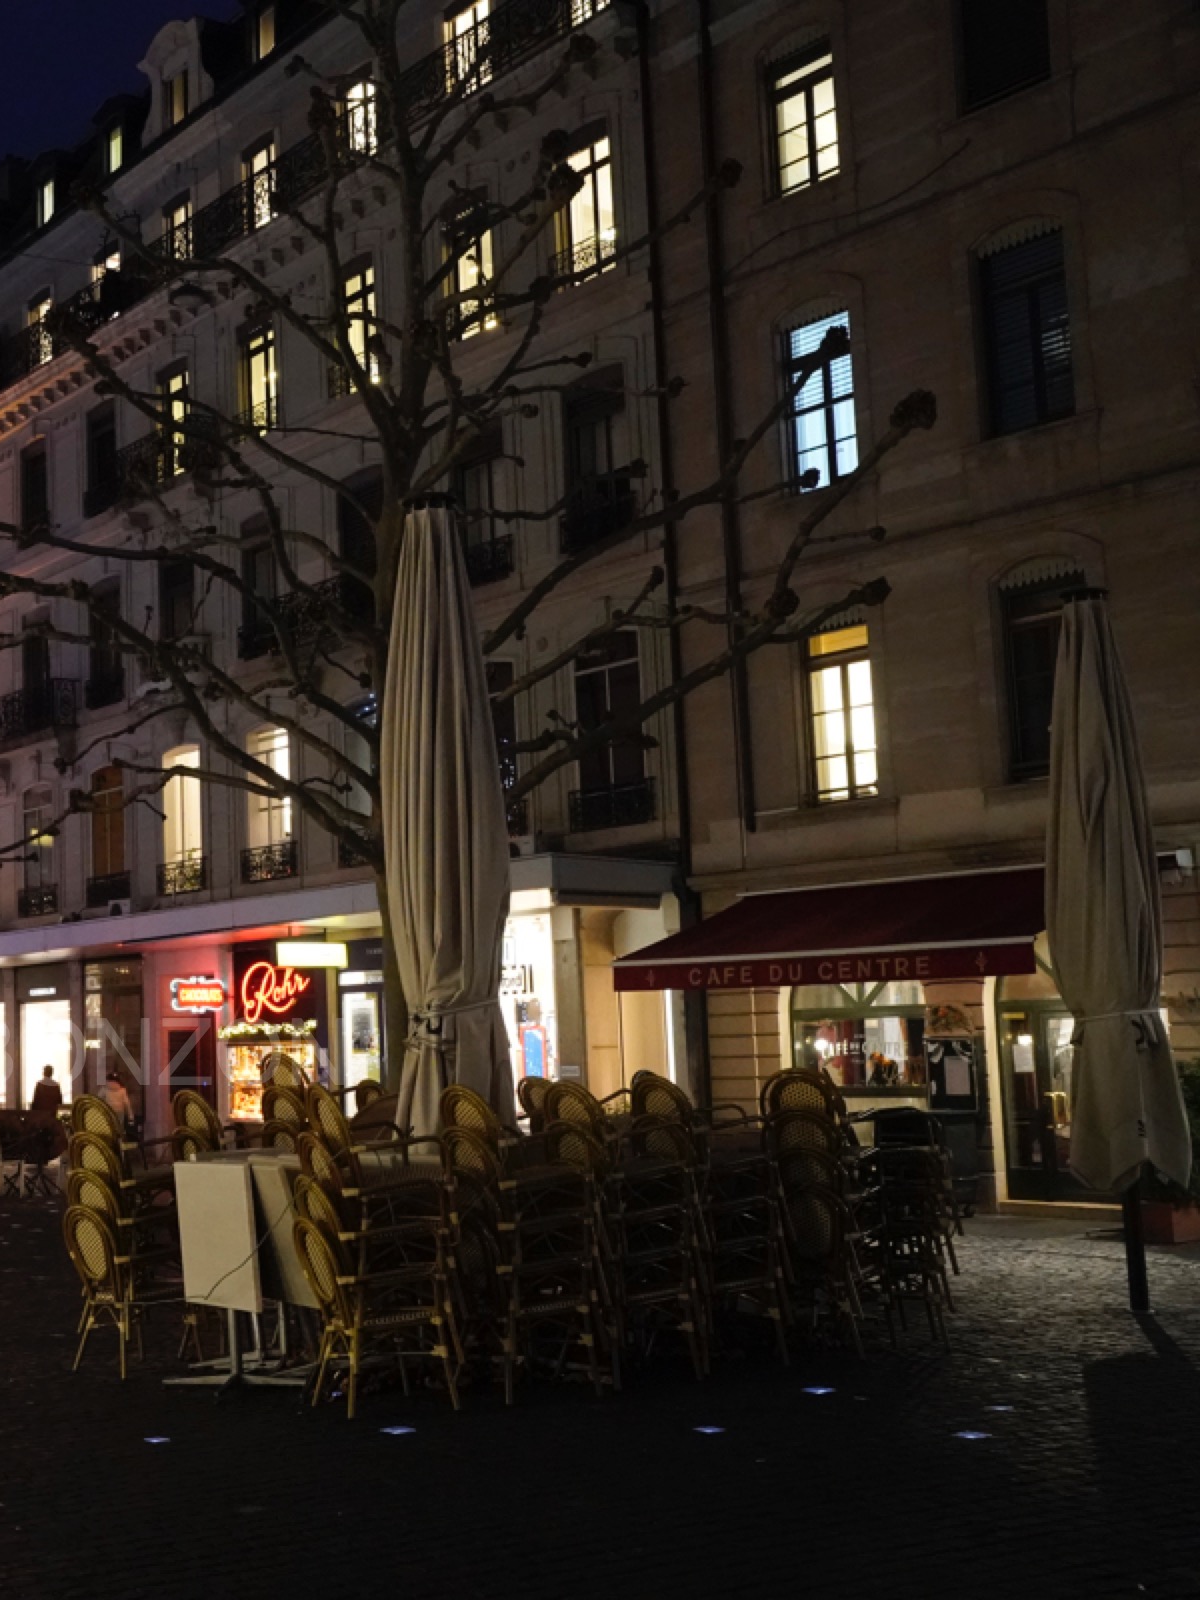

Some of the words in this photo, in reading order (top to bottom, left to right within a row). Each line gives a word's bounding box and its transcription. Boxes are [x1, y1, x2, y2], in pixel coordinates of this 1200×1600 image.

[241, 961, 310, 1023] Rohr
[687, 966, 753, 986] CAFE
[769, 963, 803, 983] DU
[817, 955, 930, 981] CENTRE
